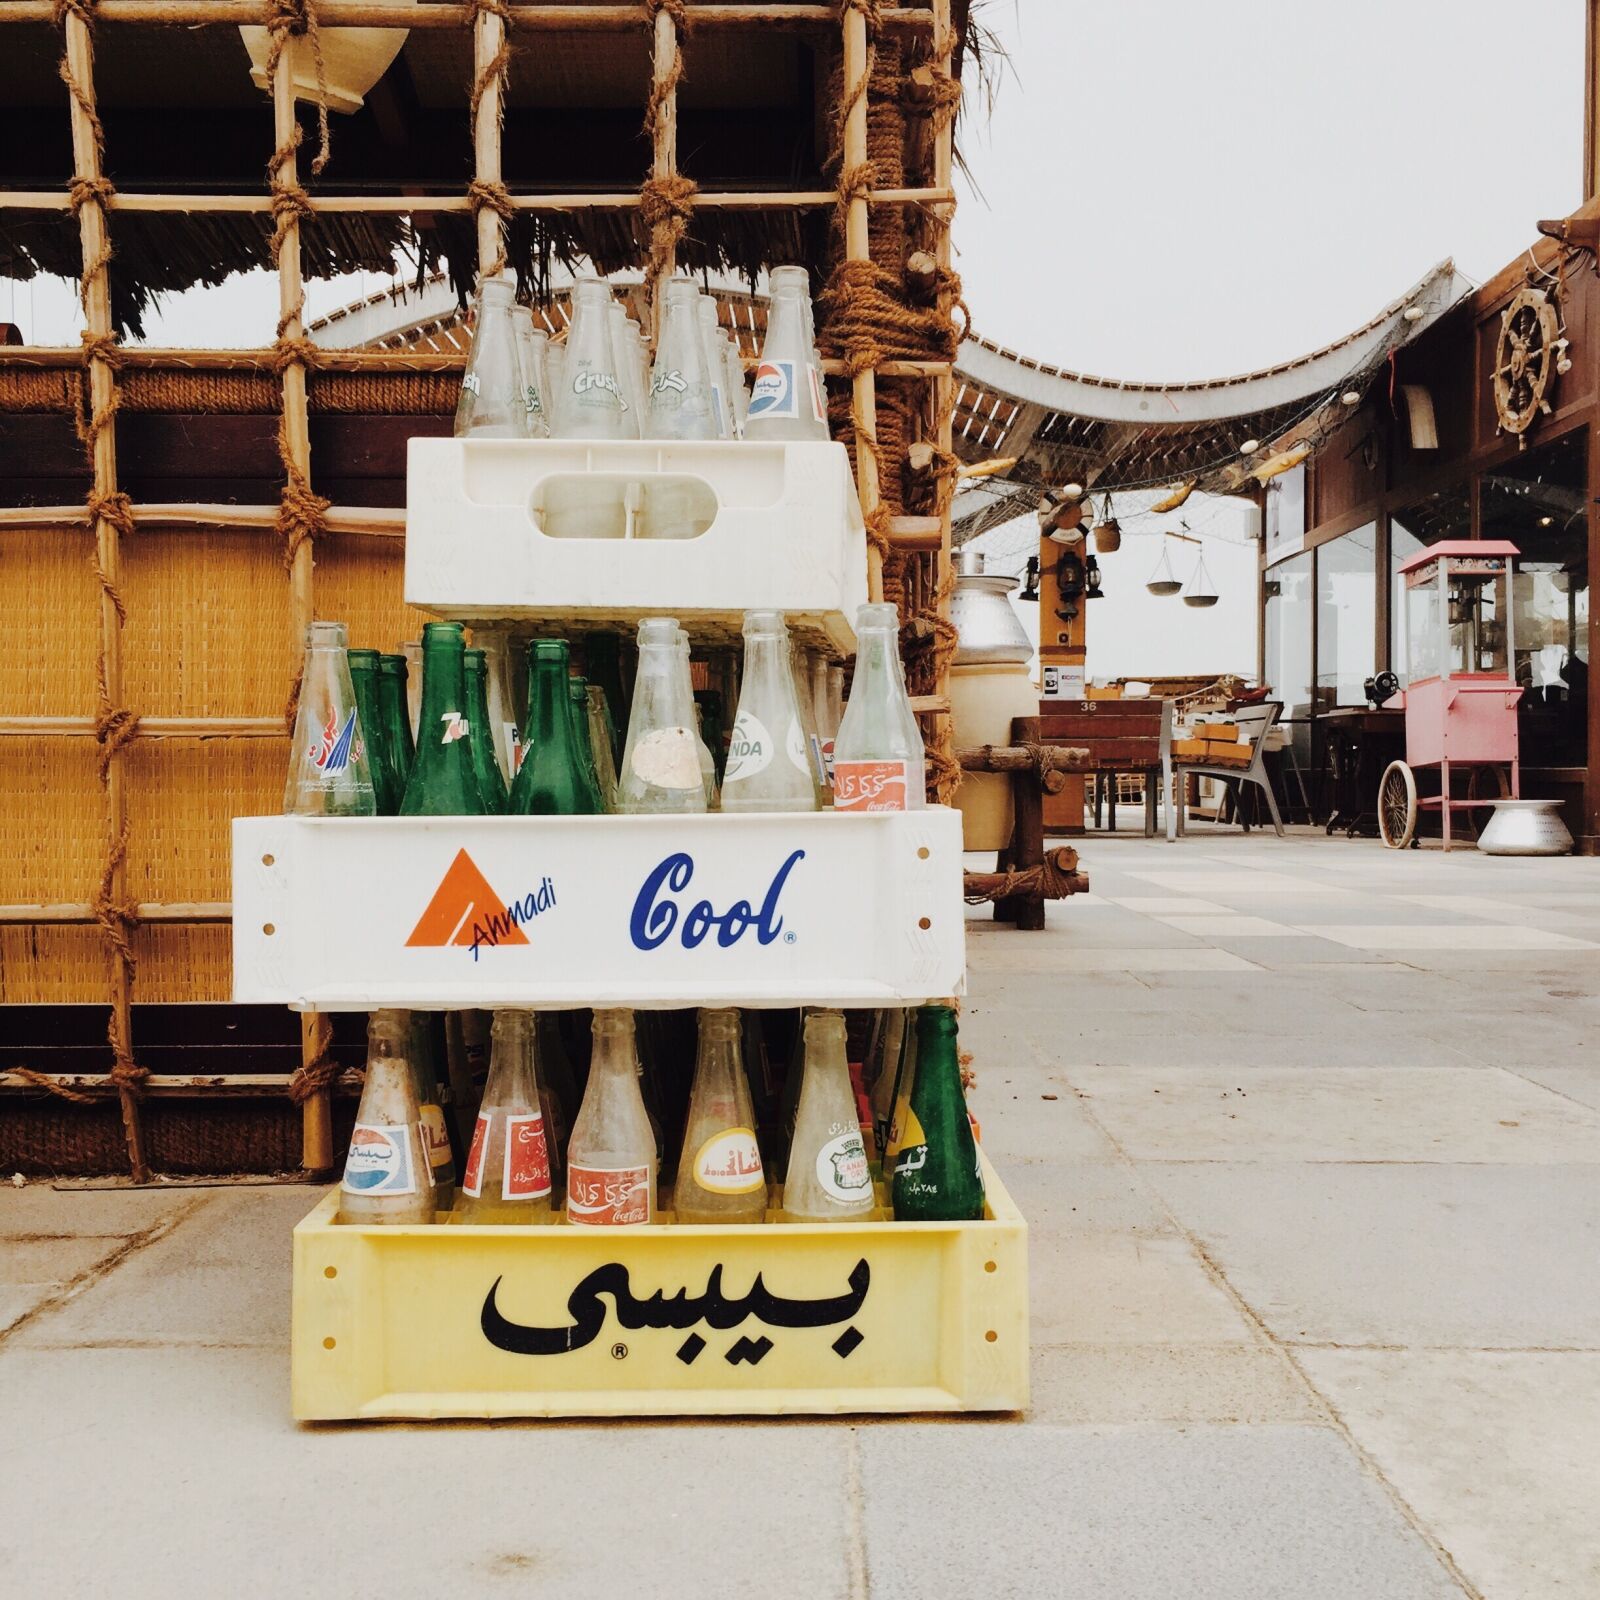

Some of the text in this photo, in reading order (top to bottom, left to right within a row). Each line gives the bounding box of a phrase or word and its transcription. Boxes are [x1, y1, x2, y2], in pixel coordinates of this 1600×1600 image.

[1080, 701, 1097, 712] 36
[469, 877, 557, 962] Ahmadi
[630, 849, 806, 951] Cool
[575, 1178, 632, 1207] كوكا كولا
